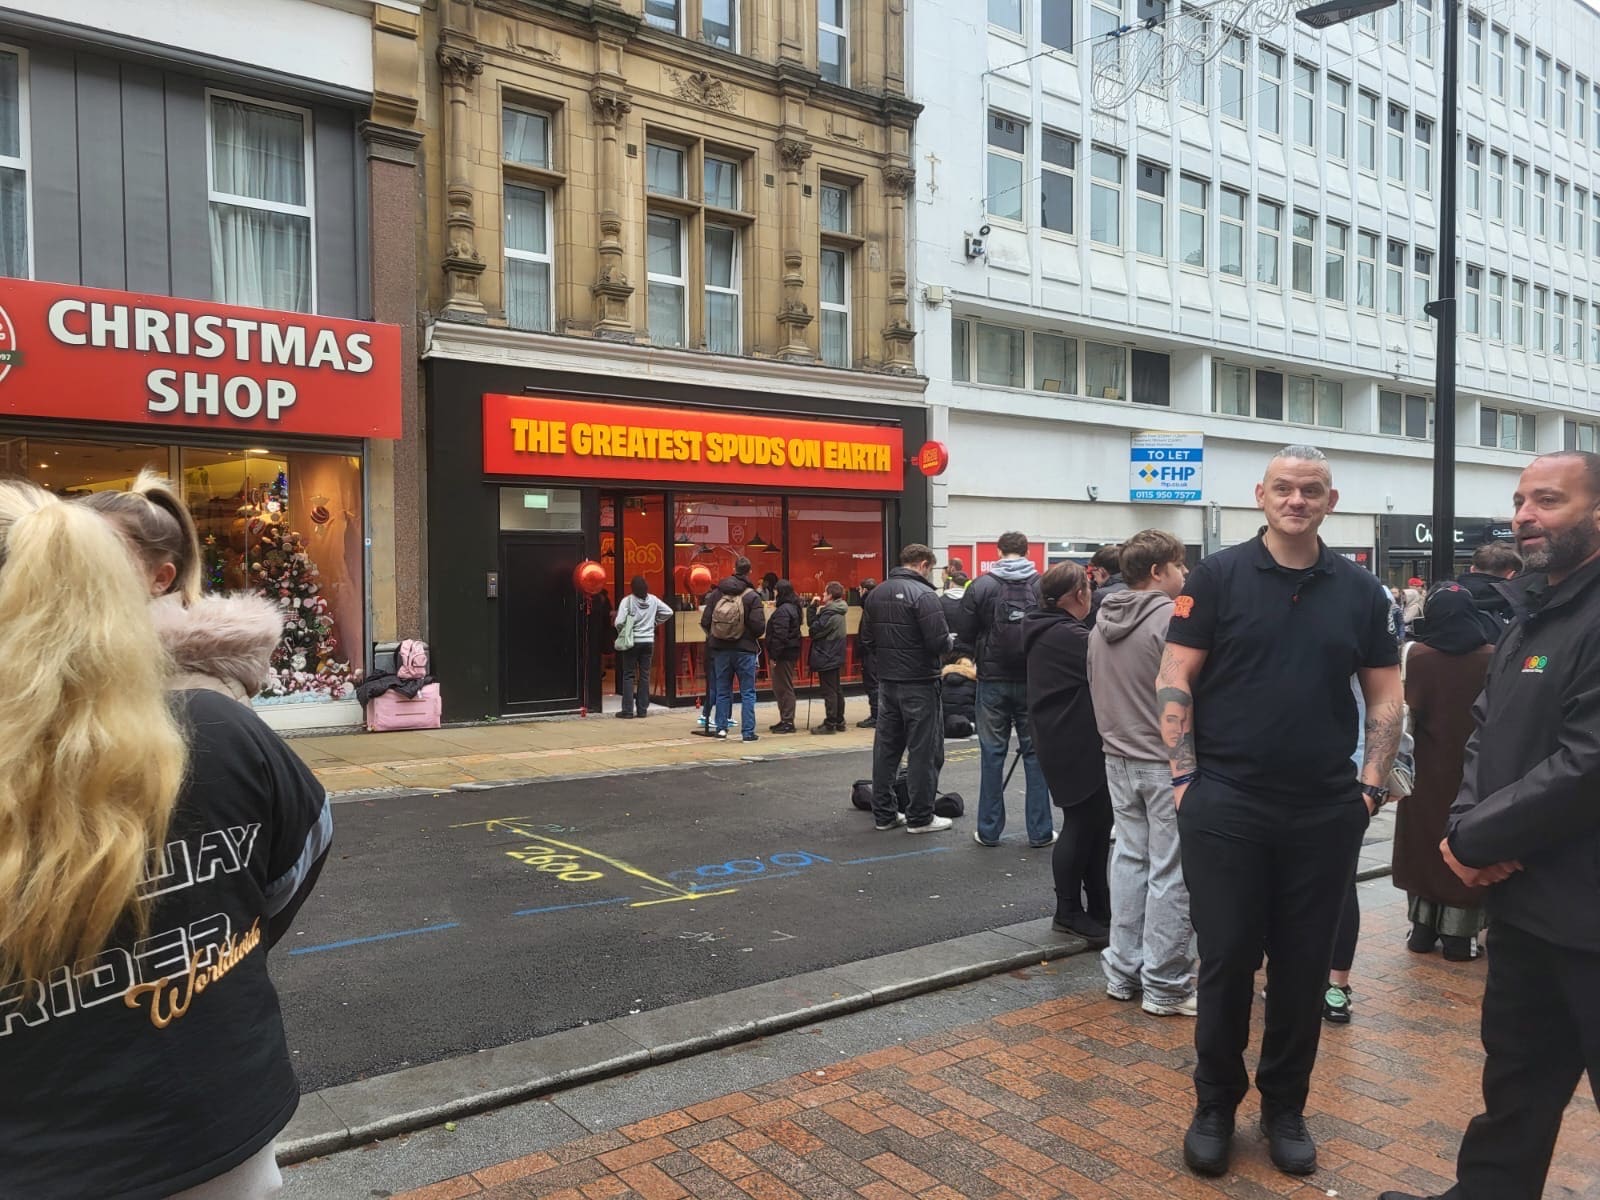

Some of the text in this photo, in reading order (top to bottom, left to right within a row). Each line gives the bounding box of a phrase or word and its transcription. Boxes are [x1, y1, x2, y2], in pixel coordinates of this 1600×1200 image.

[48, 299, 373, 373] CHRISTMAS
[147, 369, 297, 420] SHOP
[511, 418, 567, 454] THE
[571, 423, 702, 461] GREATEST
[706, 432, 785, 466] SPUDS
[788, 439, 820, 468] ON
[824, 441, 891, 471] EARTH
[1147, 450, 1191, 460] TO LET
[1135, 491, 1196, 499] 0115 950 7577
[1161, 466, 1195, 481] FHP
[505, 845, 604, 881] 2600
[124, 915, 262, 1029] Worldwide
